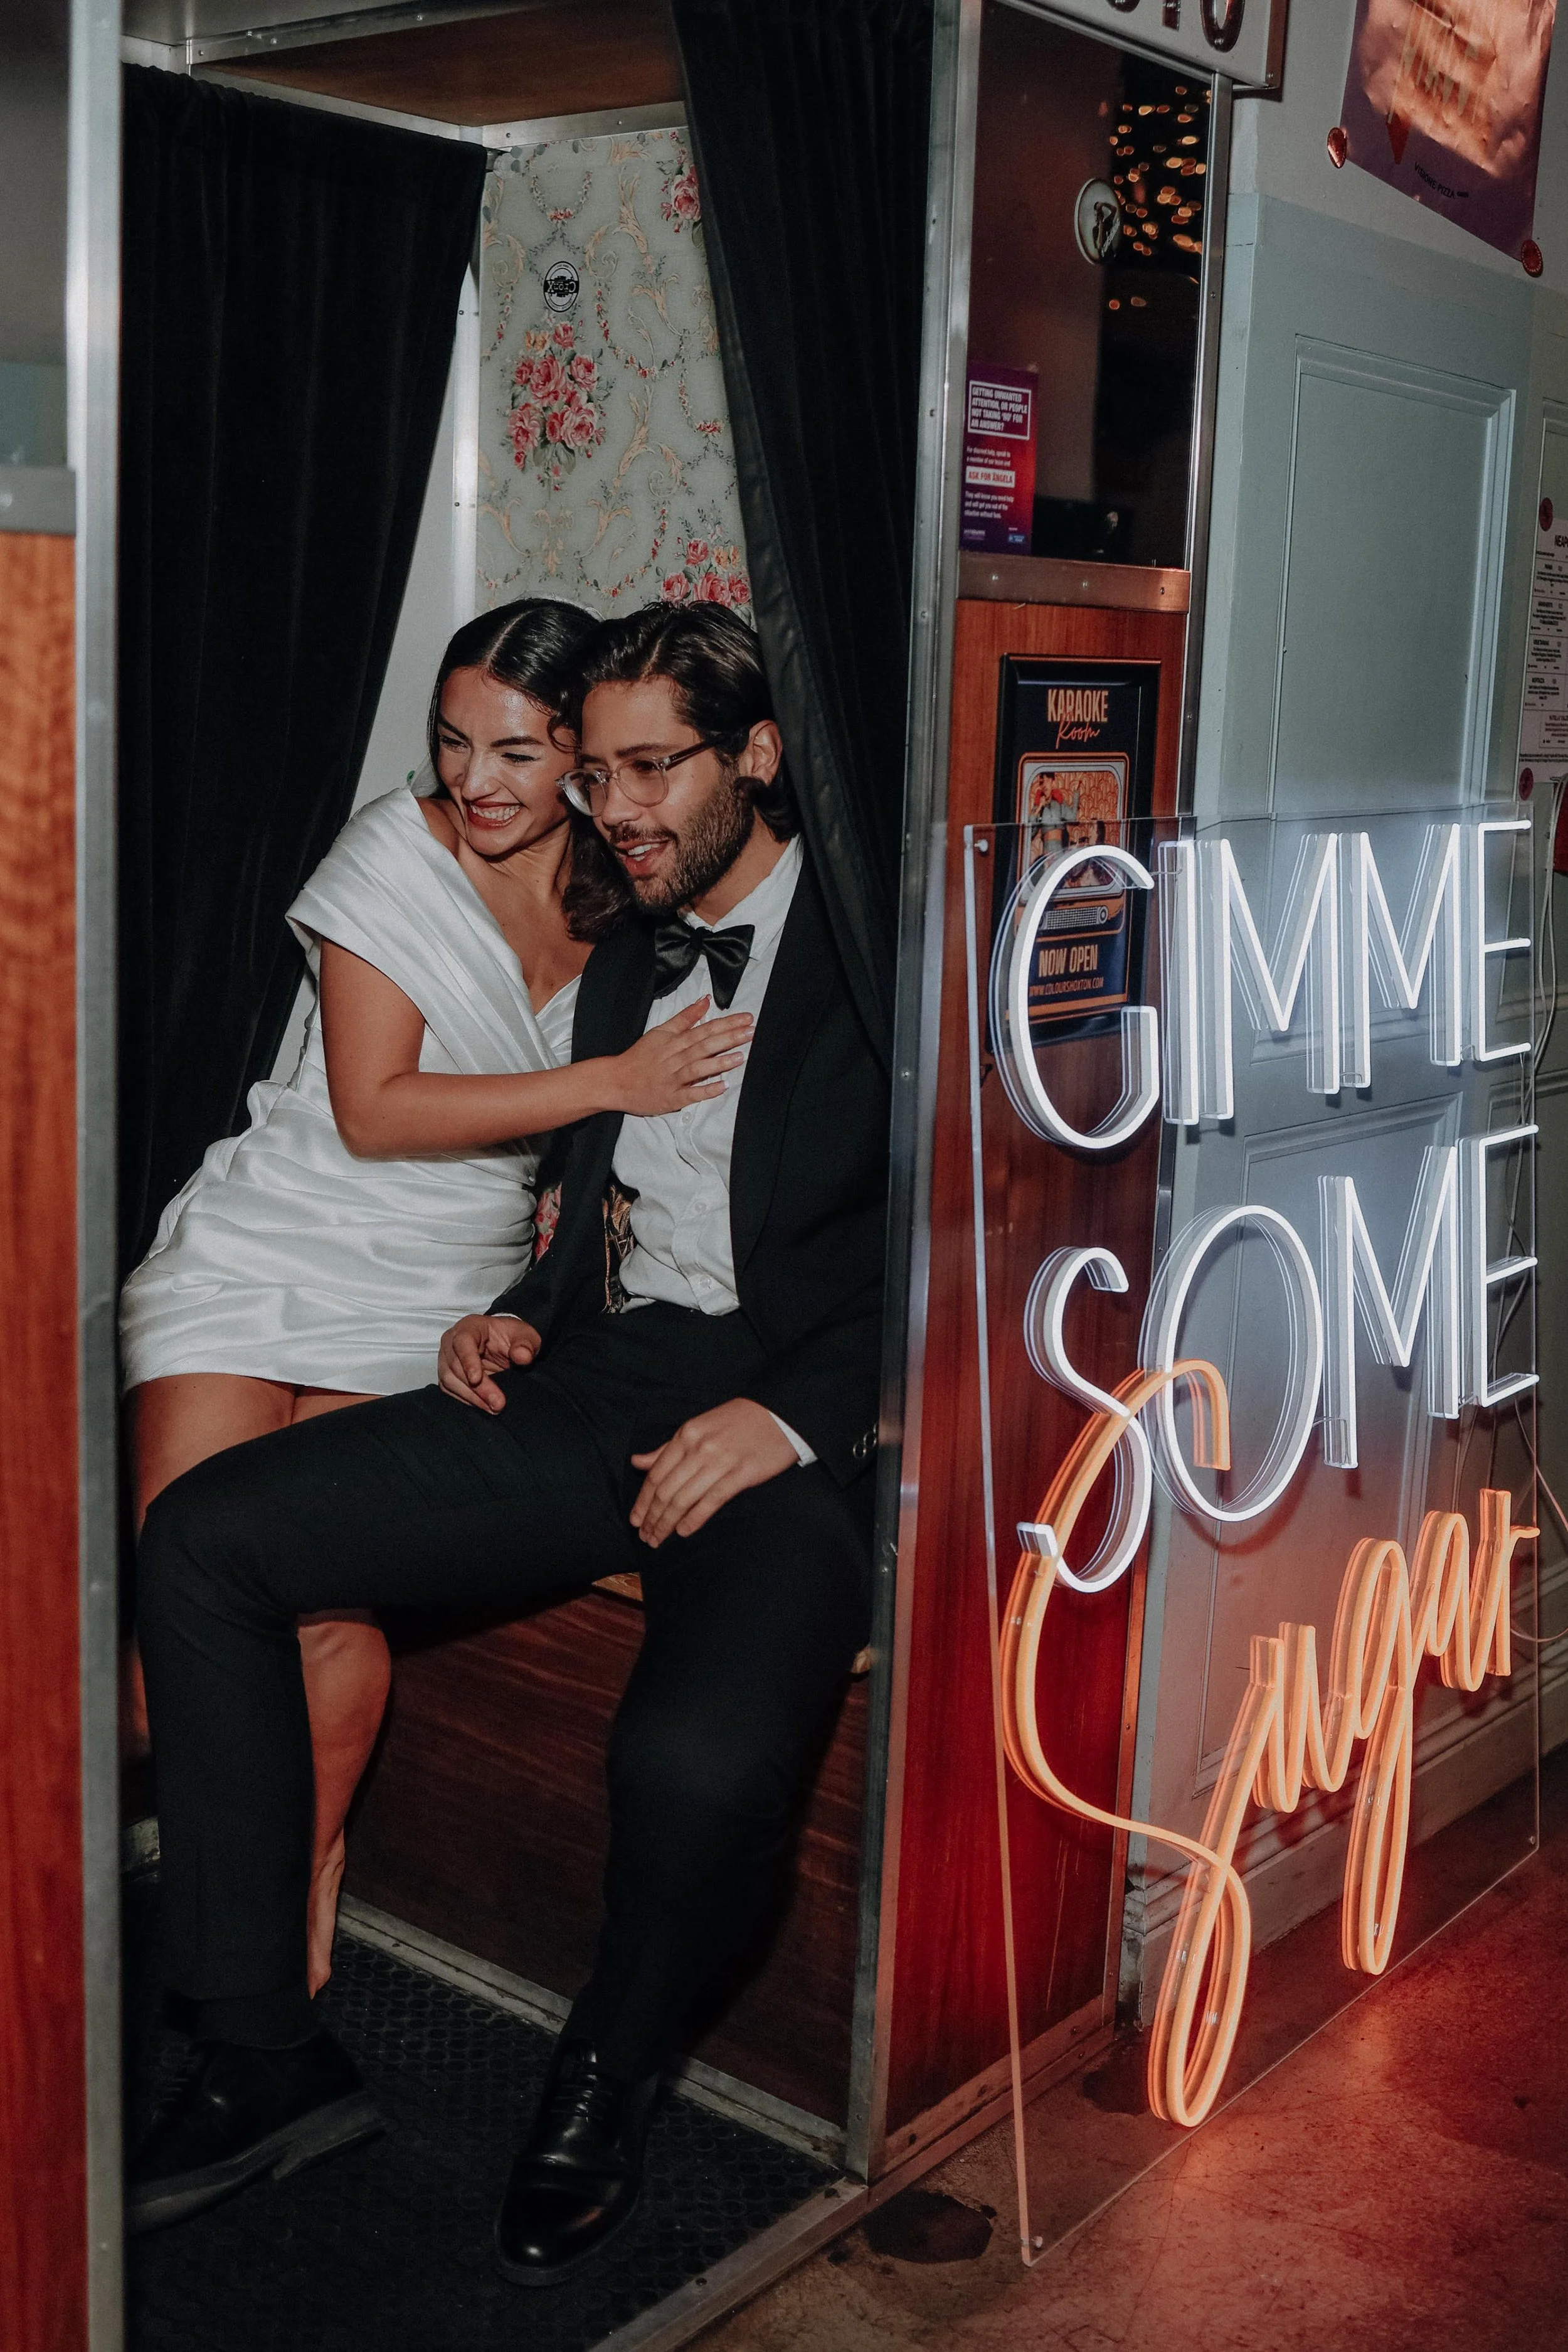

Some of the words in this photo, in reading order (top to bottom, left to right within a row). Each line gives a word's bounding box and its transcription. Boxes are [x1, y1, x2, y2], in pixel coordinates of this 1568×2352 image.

[1438, 183, 1456, 199] PIZZA
[972, 386, 993, 398] GETTING
[994, 390, 1022, 402] UNWANTED
[972, 408, 982, 418] NOT
[1012, 413, 1023, 423] FOR
[1009, 402, 1027, 414] PEOPLE
[979, 420, 1004, 431] ANSWER?
[968, 471, 978, 479] ASK
[981, 472, 990, 481] FOR
[992, 472, 1012, 483] ANGELA
[1047, 689, 1108, 722] KARAOKE
[1056, 705, 1100, 749] Room
[1039, 947, 1067, 977] NOW
[1069, 944, 1098, 973] OPEN
[1004, 819, 1532, 1149] GIMME
[1017, 1123, 1540, 1594] SOME
[1002, 1358, 1541, 2127] Sugar
